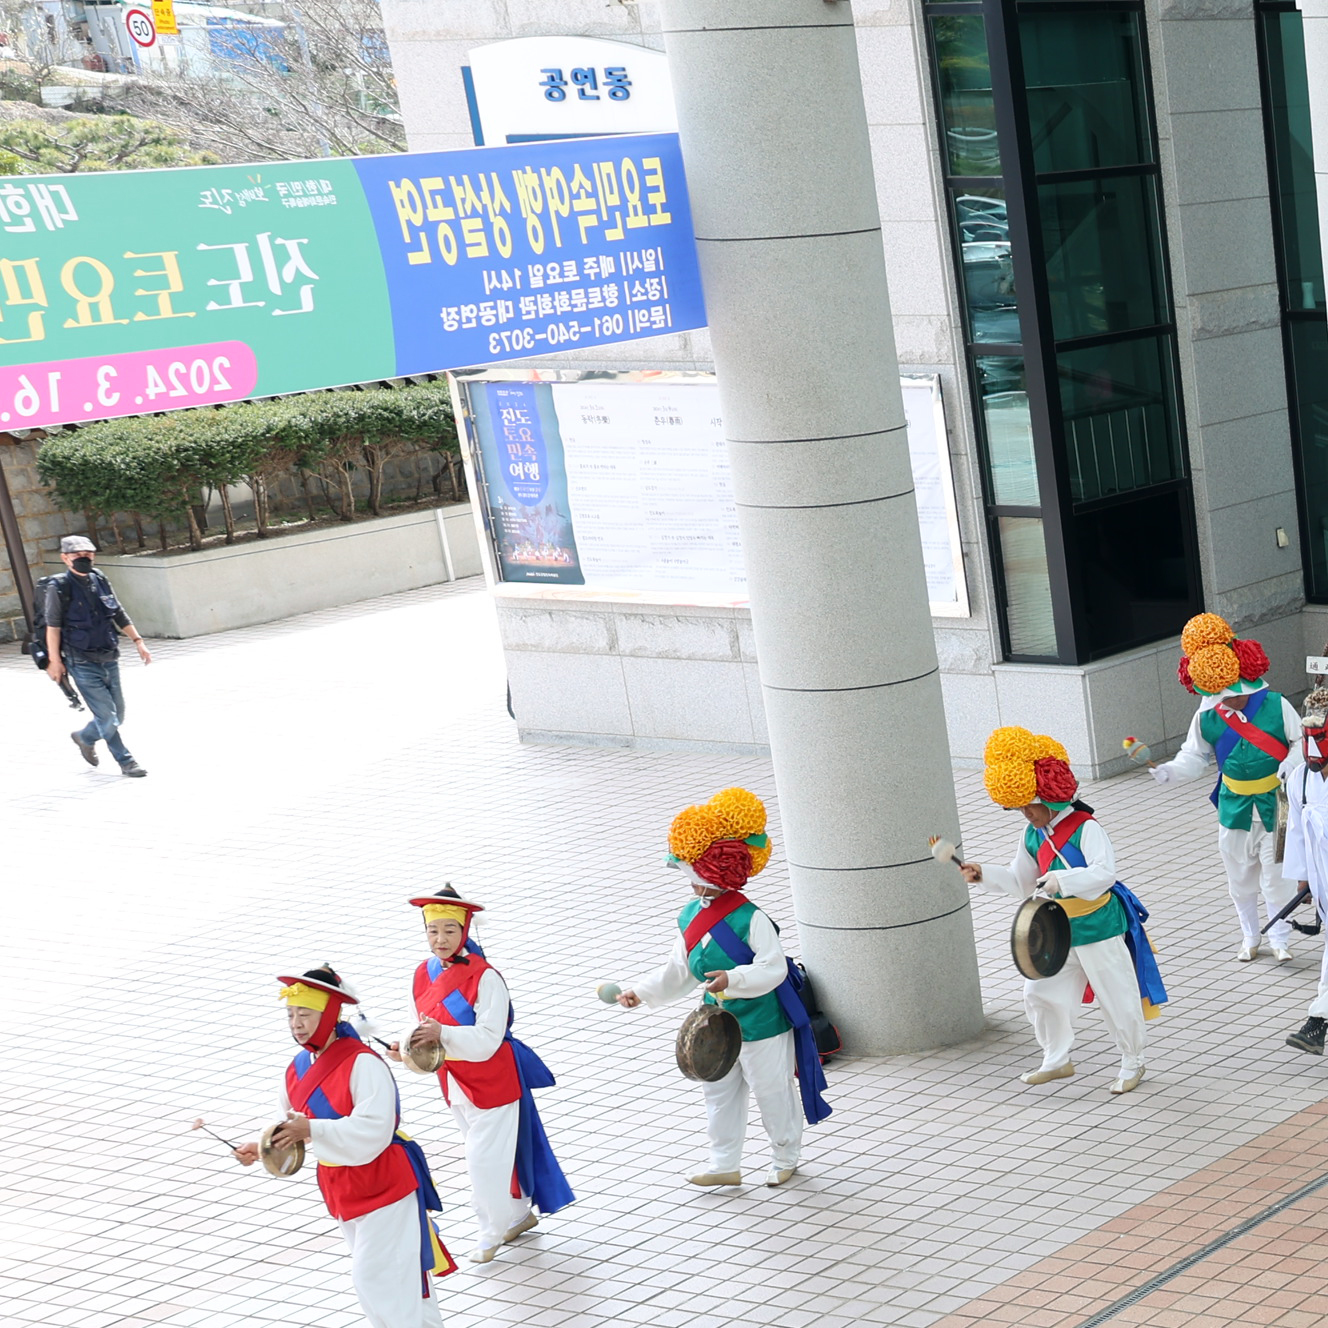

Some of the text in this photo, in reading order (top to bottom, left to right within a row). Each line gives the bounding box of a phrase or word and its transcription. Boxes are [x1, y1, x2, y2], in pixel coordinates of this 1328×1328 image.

[133, 20, 149, 37] 50
[539, 67, 632, 102] 공연동
[501, 408, 532, 426] 진도
[503, 427, 535, 442] 토요
[507, 444, 537, 461] 민속
[509, 462, 540, 481] 여행
